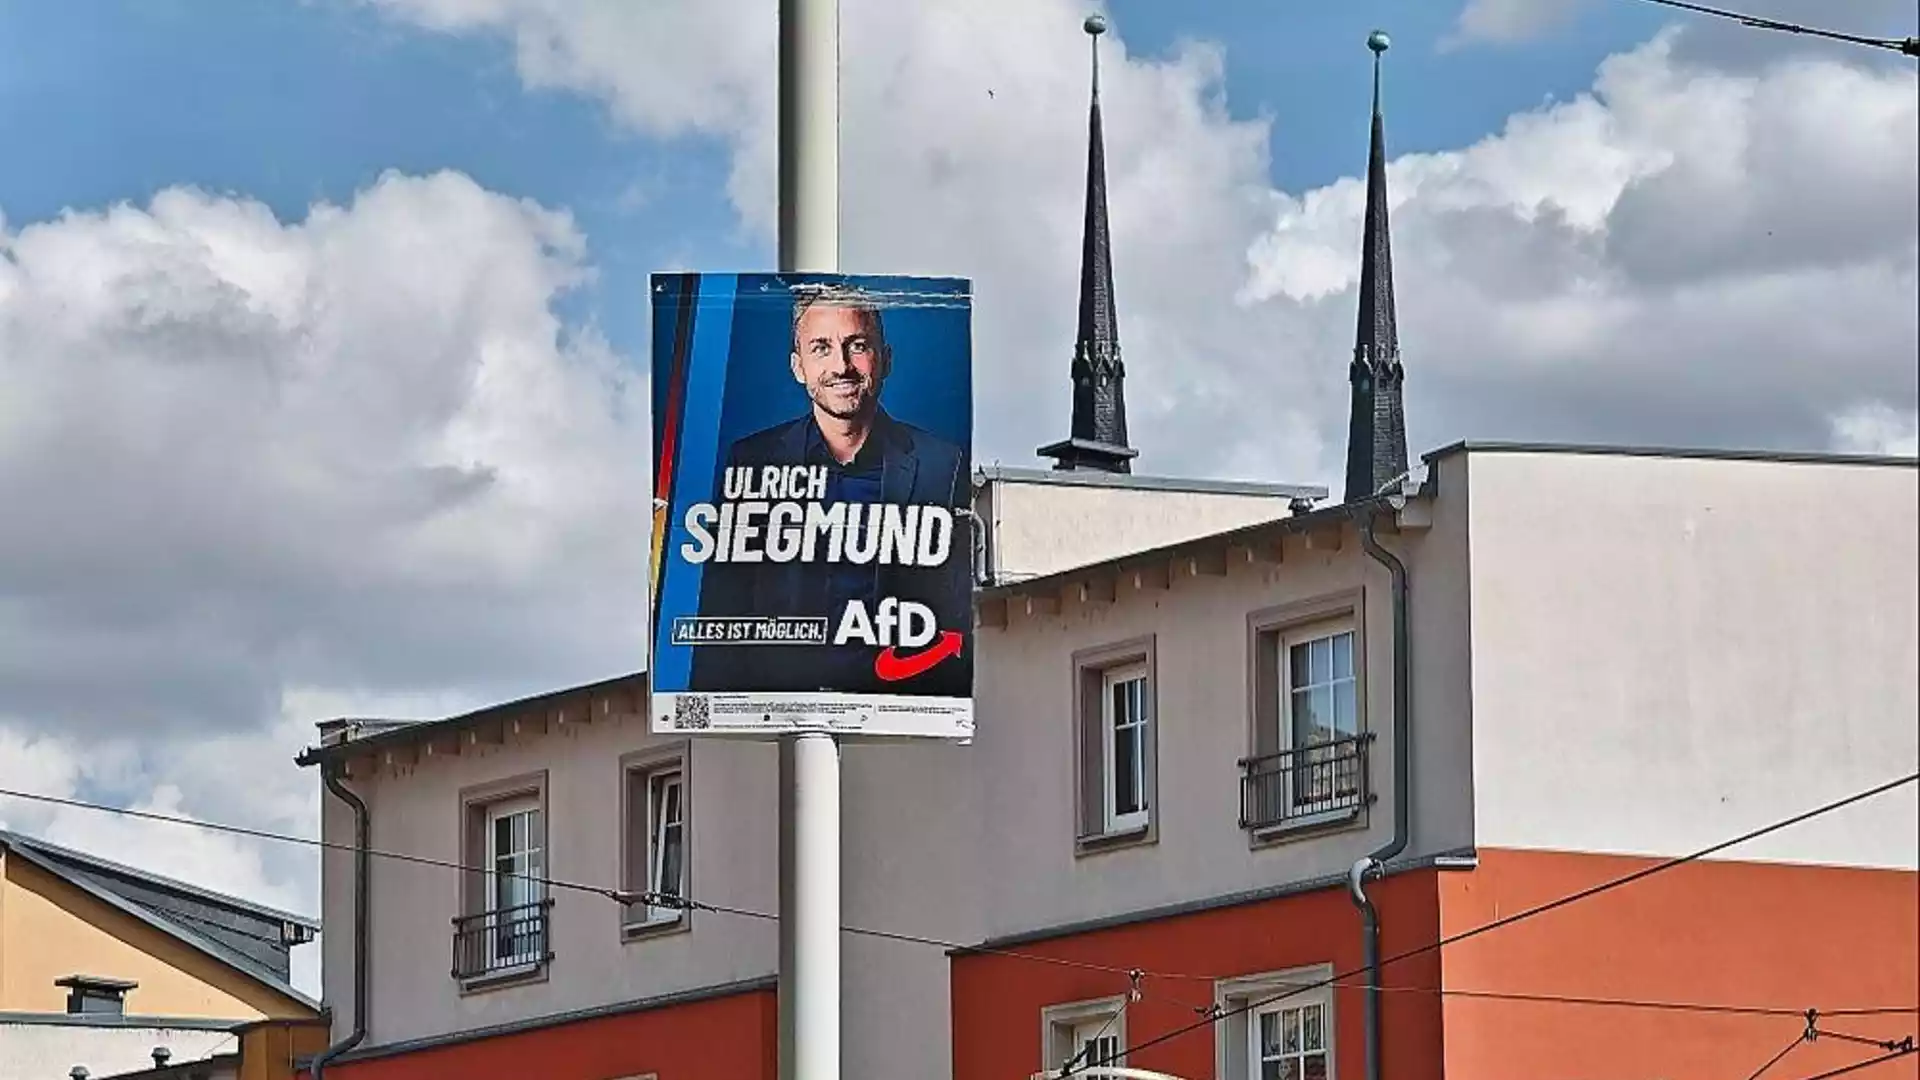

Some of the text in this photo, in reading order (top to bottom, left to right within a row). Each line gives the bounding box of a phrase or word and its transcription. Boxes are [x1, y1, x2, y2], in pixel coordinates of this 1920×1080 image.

[723, 465, 828, 499] ULRICH
[681, 502, 953, 566] SIEGMUND
[678, 617, 823, 640] ALLES IST MÖGLICH.
[833, 596, 936, 647] AfD
